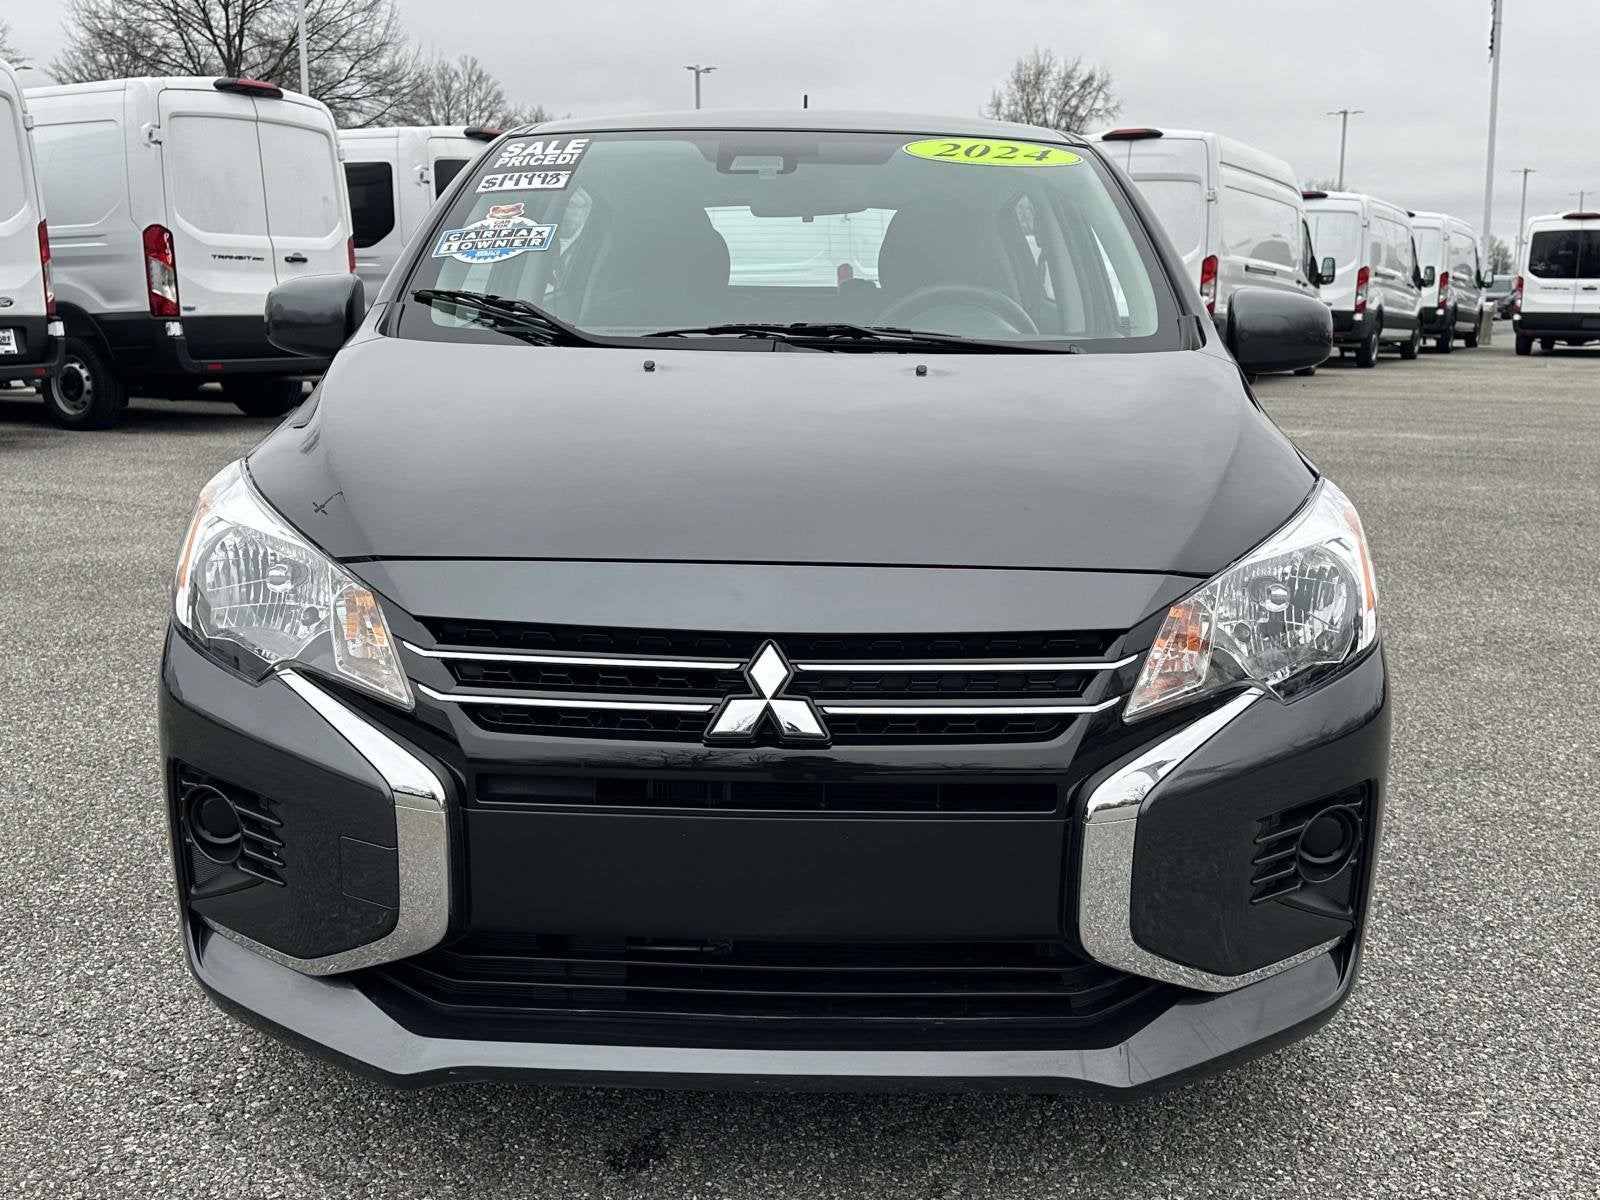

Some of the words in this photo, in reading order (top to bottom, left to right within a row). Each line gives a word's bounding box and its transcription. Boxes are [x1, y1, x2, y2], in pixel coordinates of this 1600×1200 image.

[501, 138, 589, 158] SALE
[934, 143, 1052, 161] 2024
[494, 153, 581, 168] PRICED!
[481, 172, 562, 189] $14998
[448, 227, 547, 242] CARFAX
[460, 238, 543, 250] OWNER
